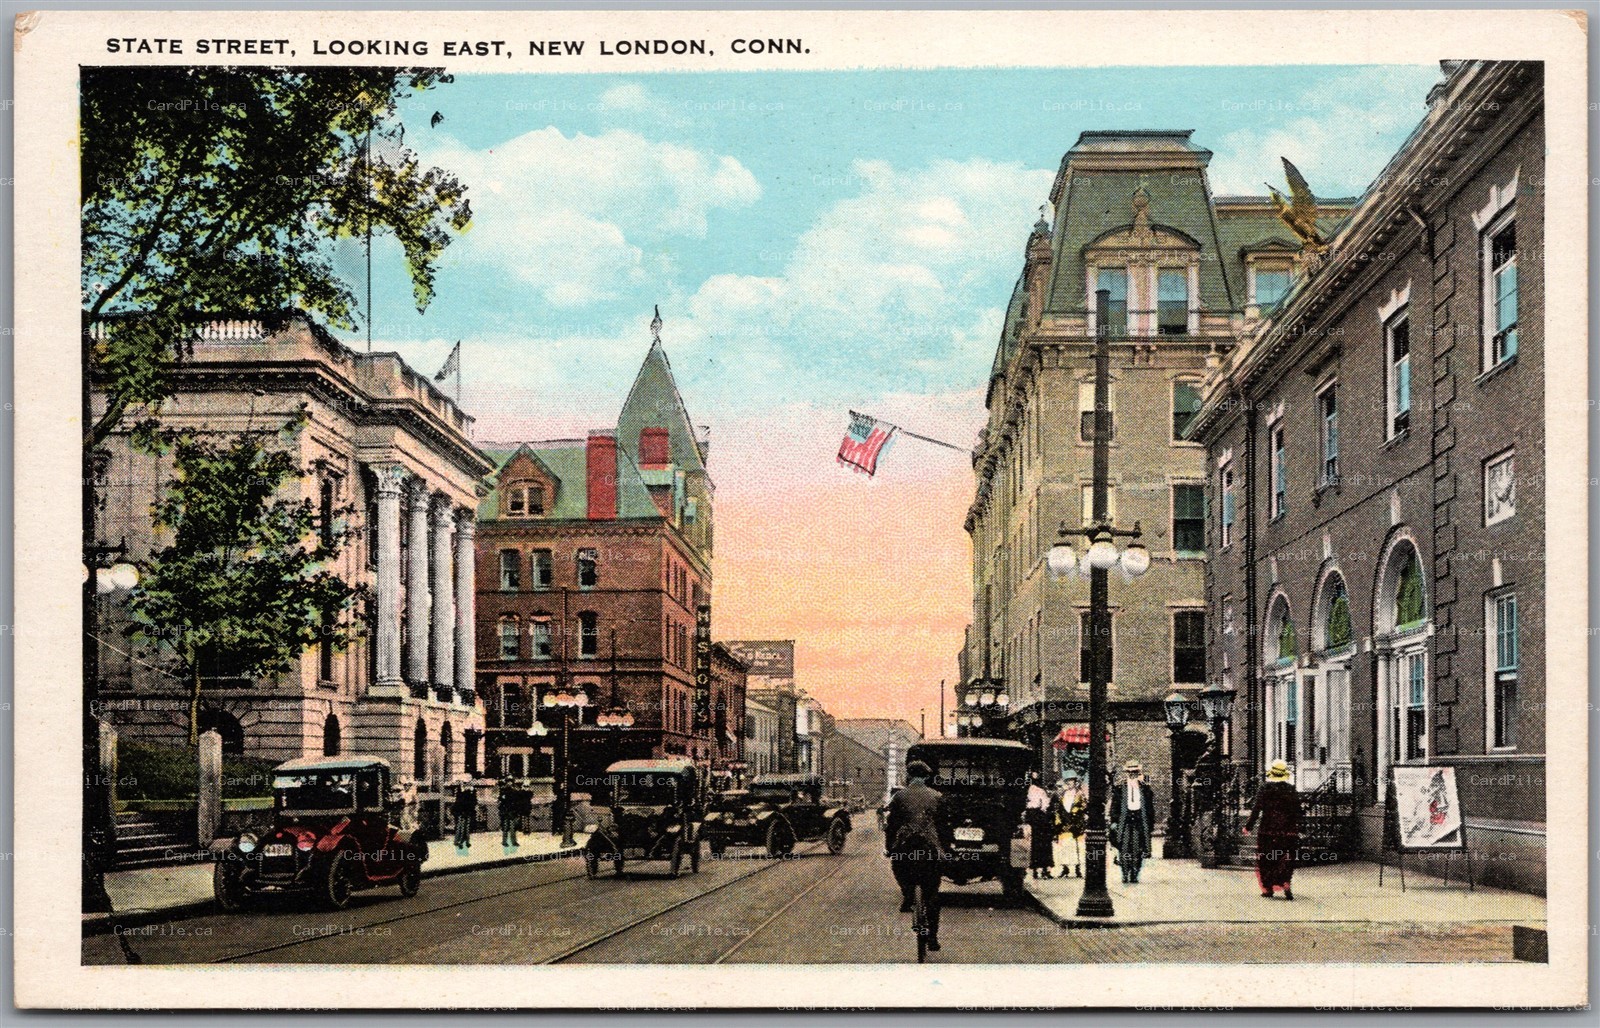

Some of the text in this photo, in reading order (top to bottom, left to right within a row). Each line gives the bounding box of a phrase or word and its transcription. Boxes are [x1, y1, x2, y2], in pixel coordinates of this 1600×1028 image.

[106, 37, 811, 59] STATE STREET, LOOKING EAST, NEW LONDON, CONN.
